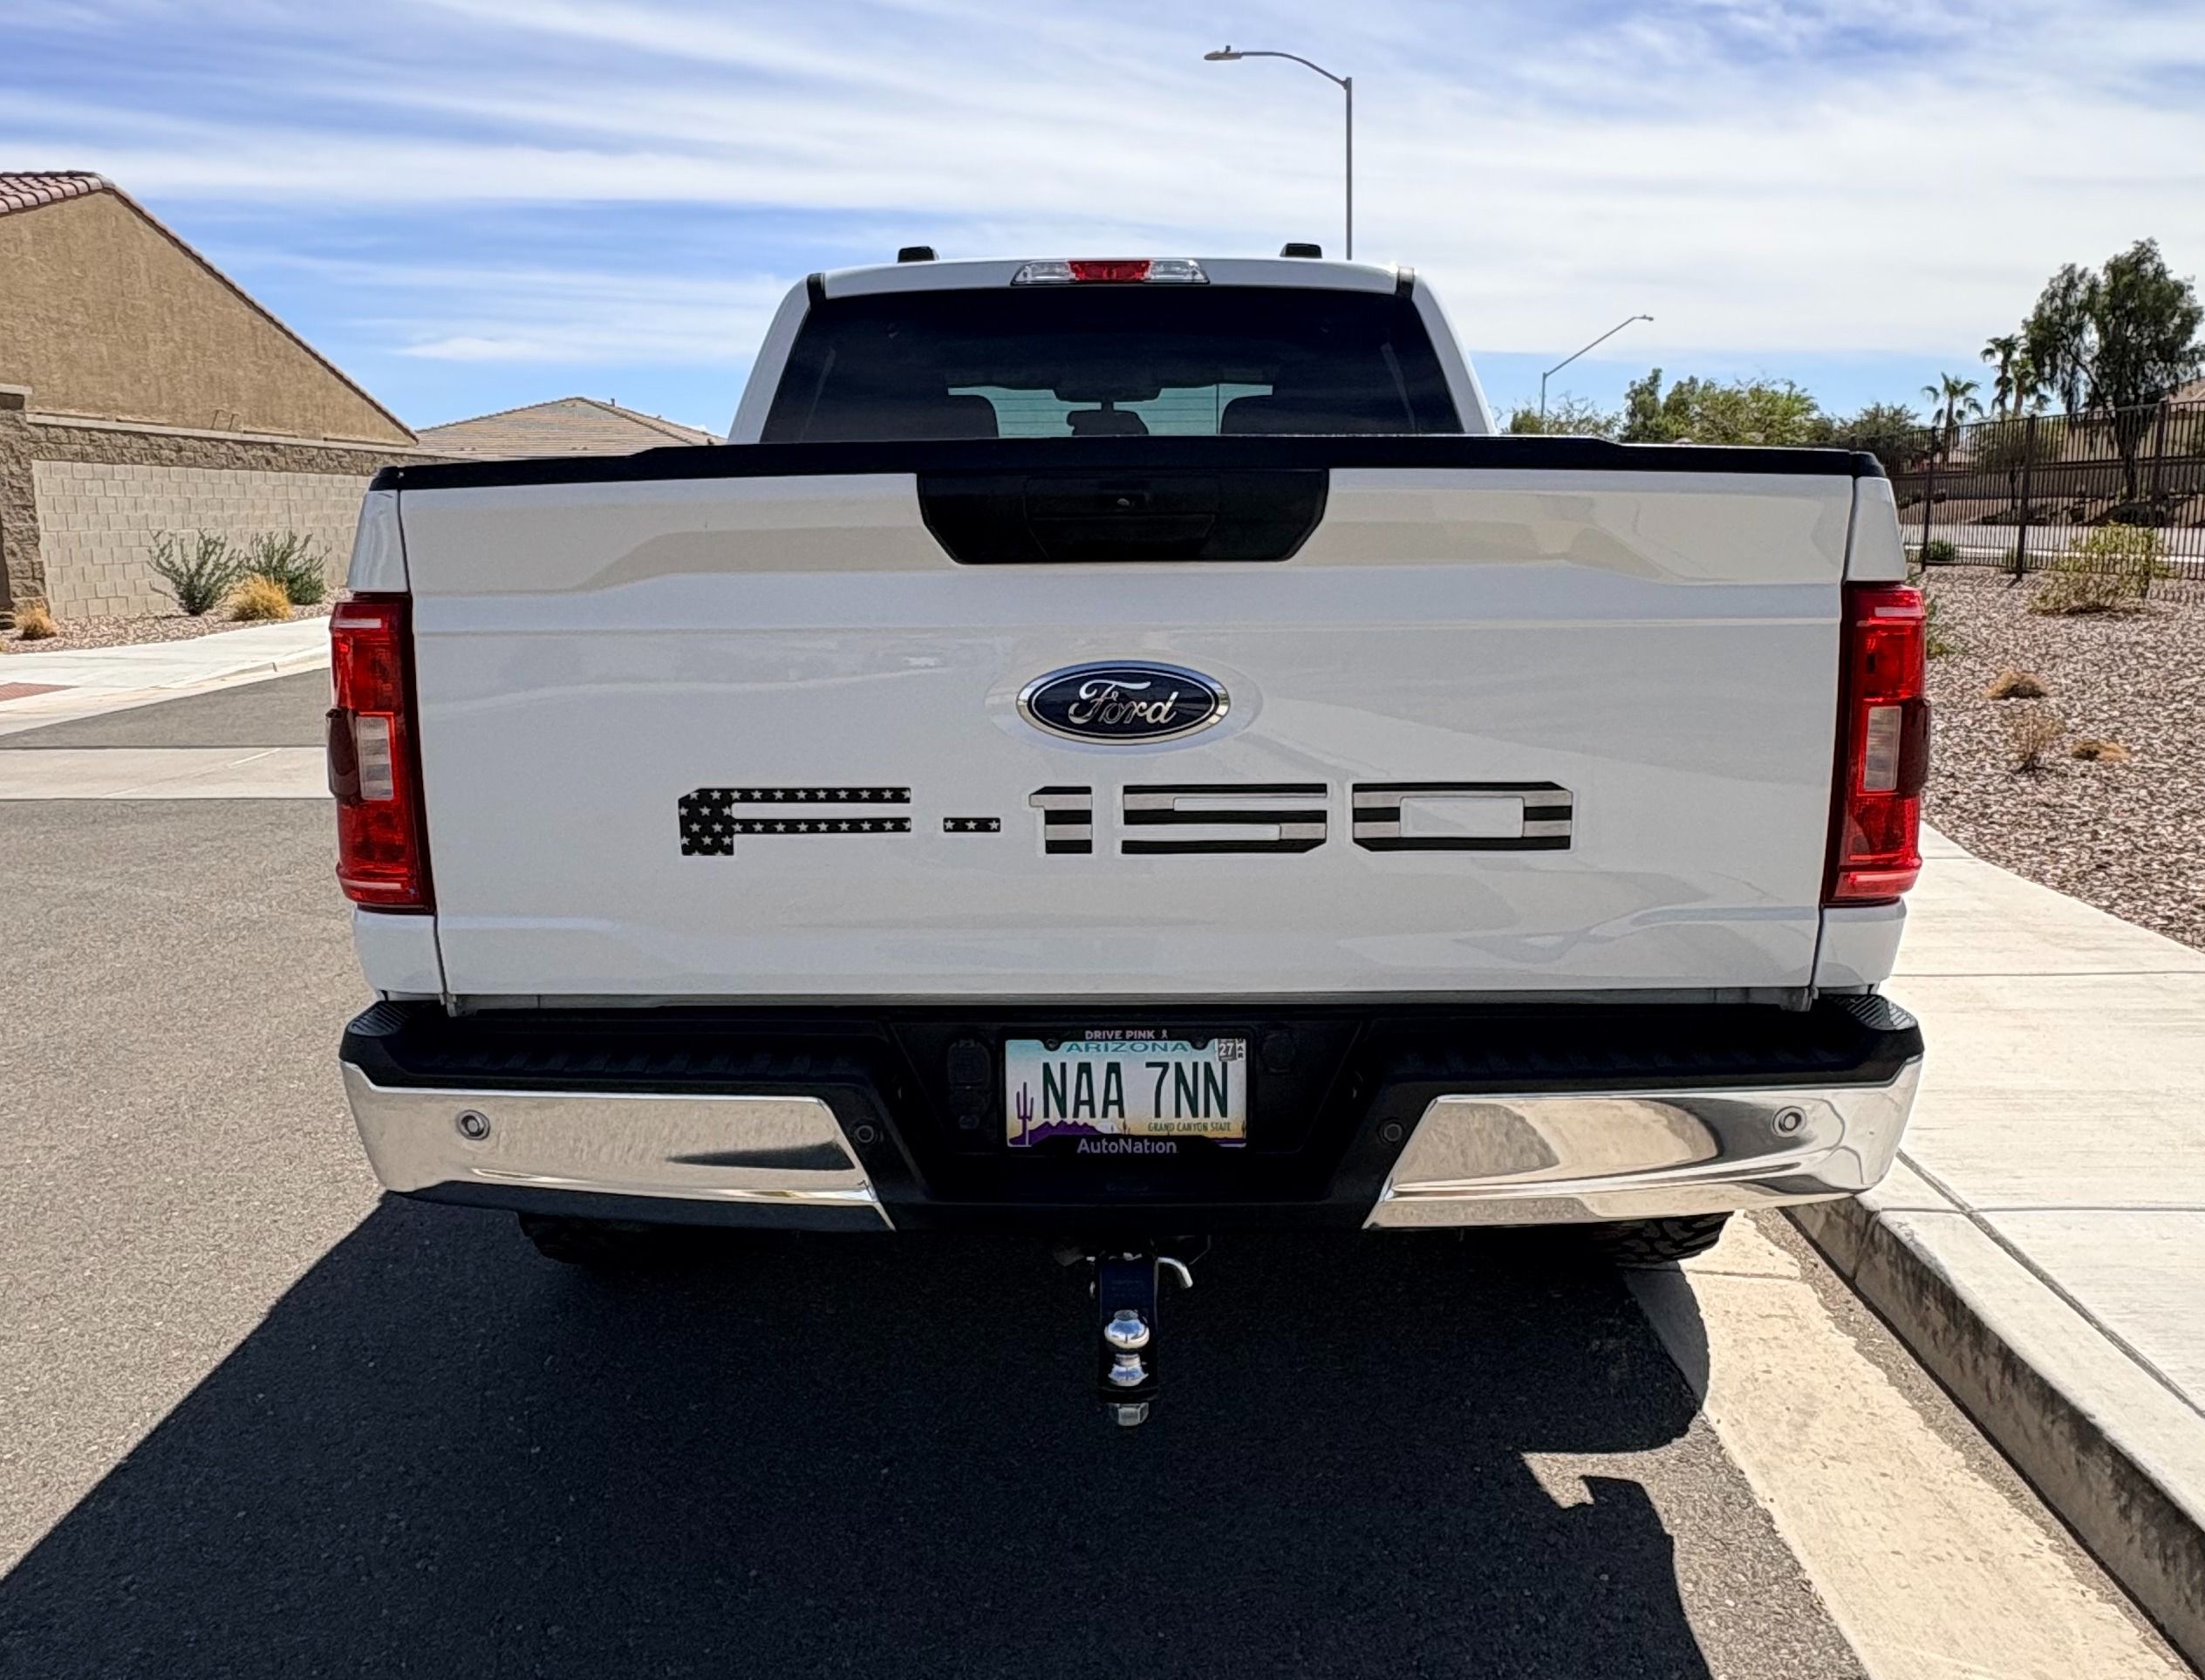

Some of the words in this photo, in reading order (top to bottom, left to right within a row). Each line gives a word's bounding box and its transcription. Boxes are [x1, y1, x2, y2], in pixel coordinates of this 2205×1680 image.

[1068, 679, 1178, 725] Ford
[678, 782, 1573, 857] F-150
[1085, 1030, 1123, 1040] DRIVE
[1126, 1030, 1155, 1040] PINK
[1066, 1041, 1189, 1053] ARIZONA
[1219, 1042, 1234, 1056] 27
[1042, 1062, 1125, 1119] NAA
[1145, 1062, 1228, 1119] 7NN
[1148, 1122, 1175, 1131] GRAND
[1177, 1122, 1208, 1131] CANYON
[1211, 1122, 1232, 1131] STATE
[1077, 1137, 1178, 1153] AutoNation
